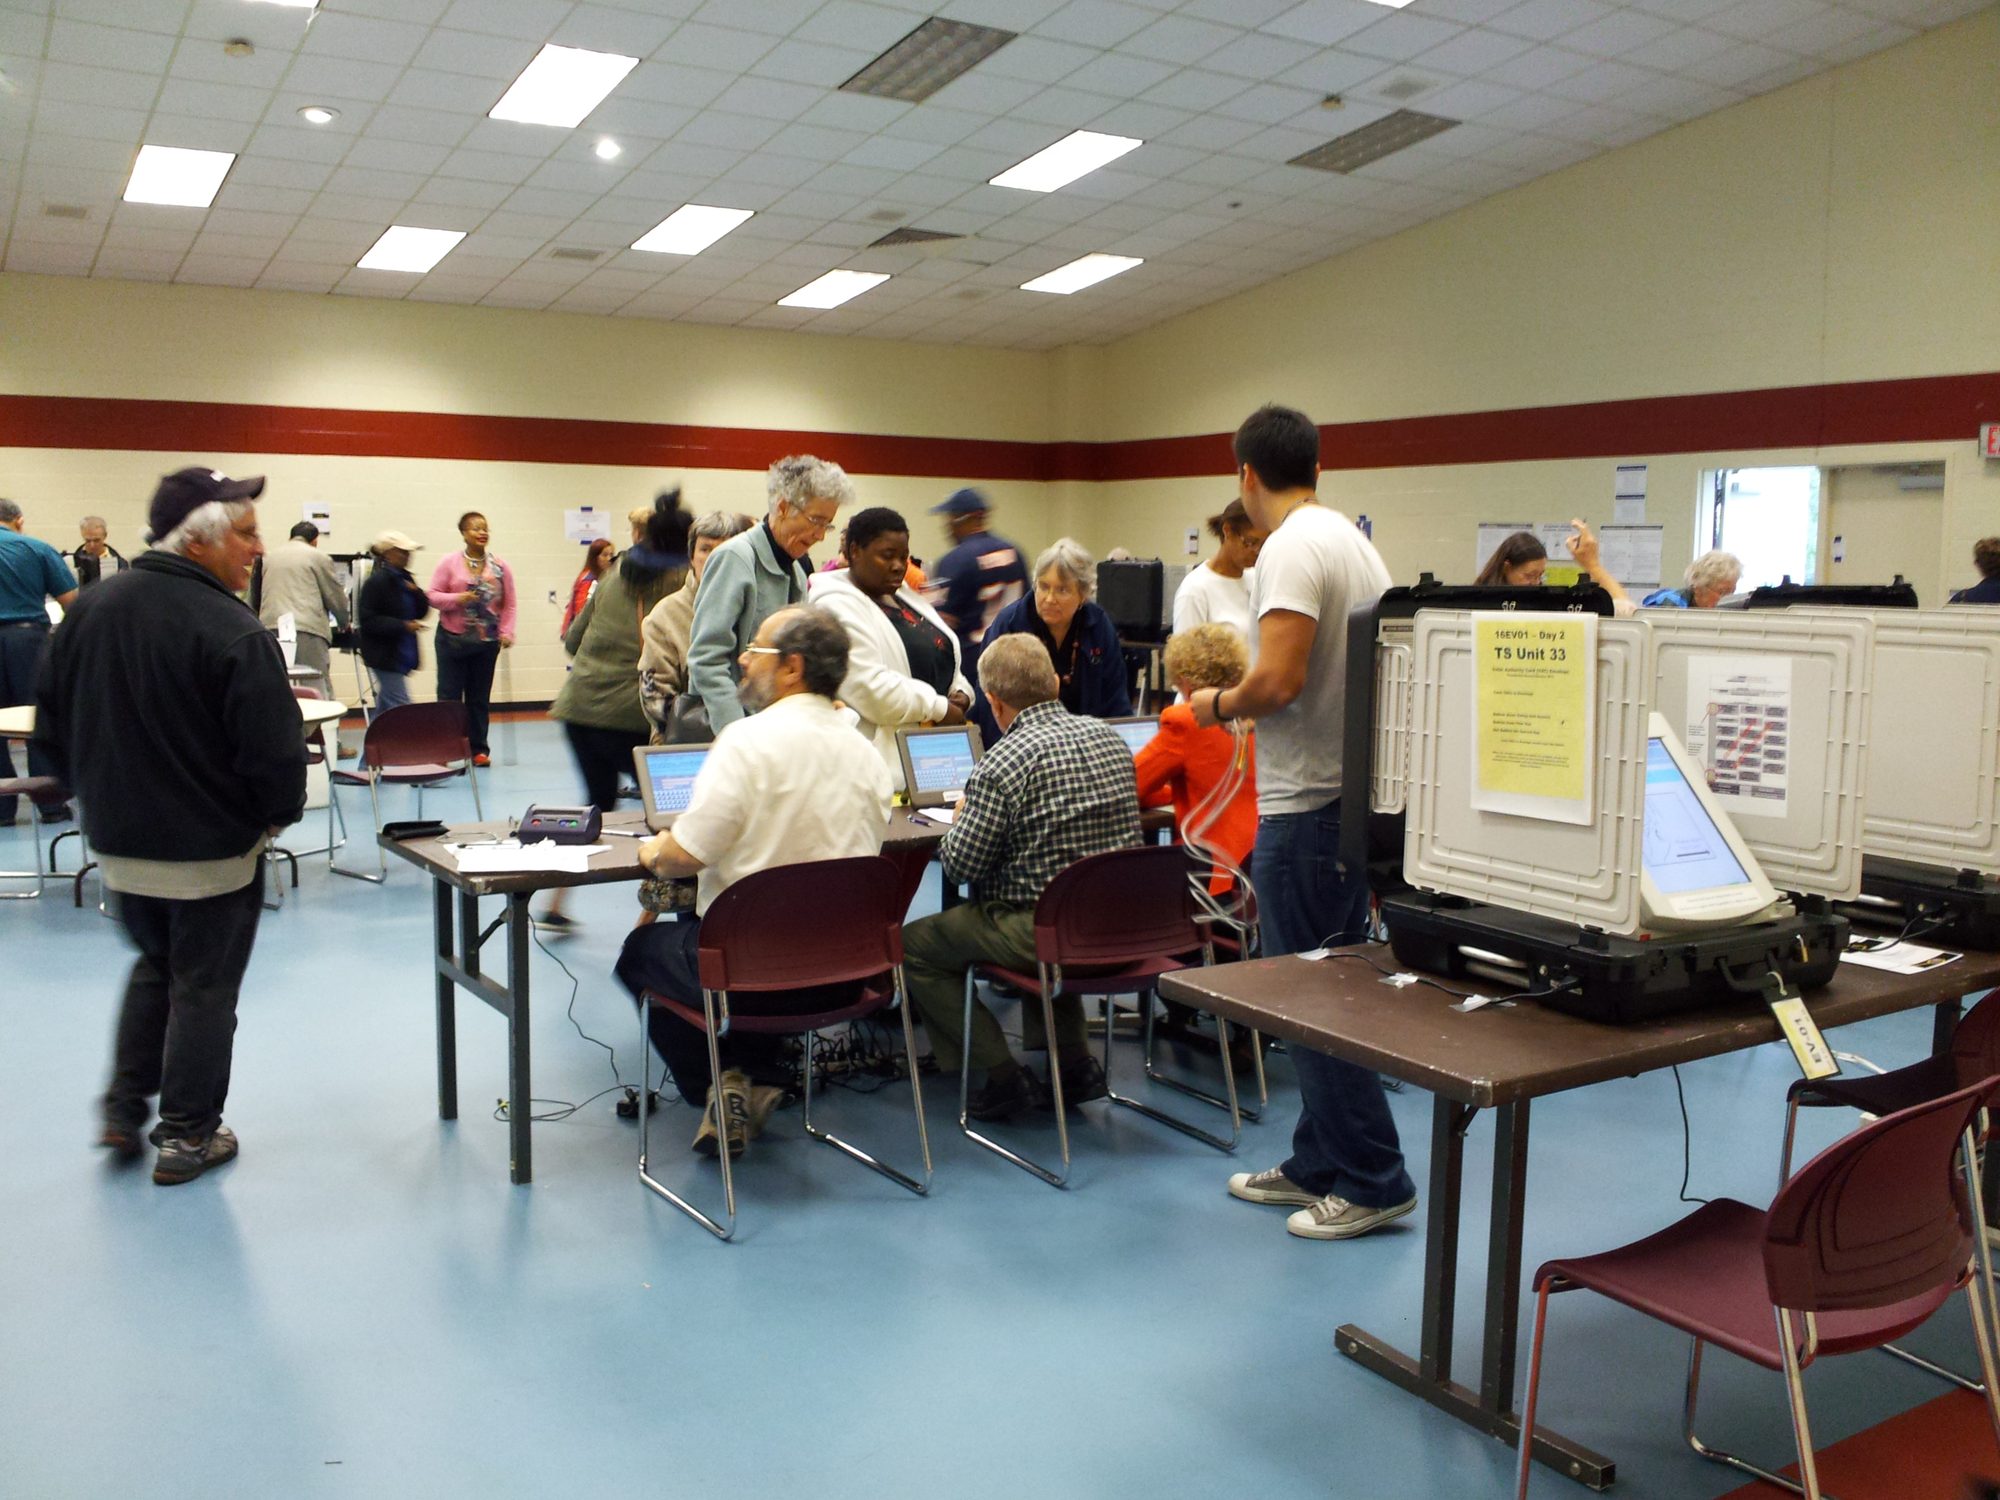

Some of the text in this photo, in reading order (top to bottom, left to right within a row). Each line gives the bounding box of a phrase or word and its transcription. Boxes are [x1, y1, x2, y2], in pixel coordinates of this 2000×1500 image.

[1539, 630, 1557, 642] Day
[1559, 631, 1566, 640] 2
[1494, 647, 1566, 661] TS Unit 33
